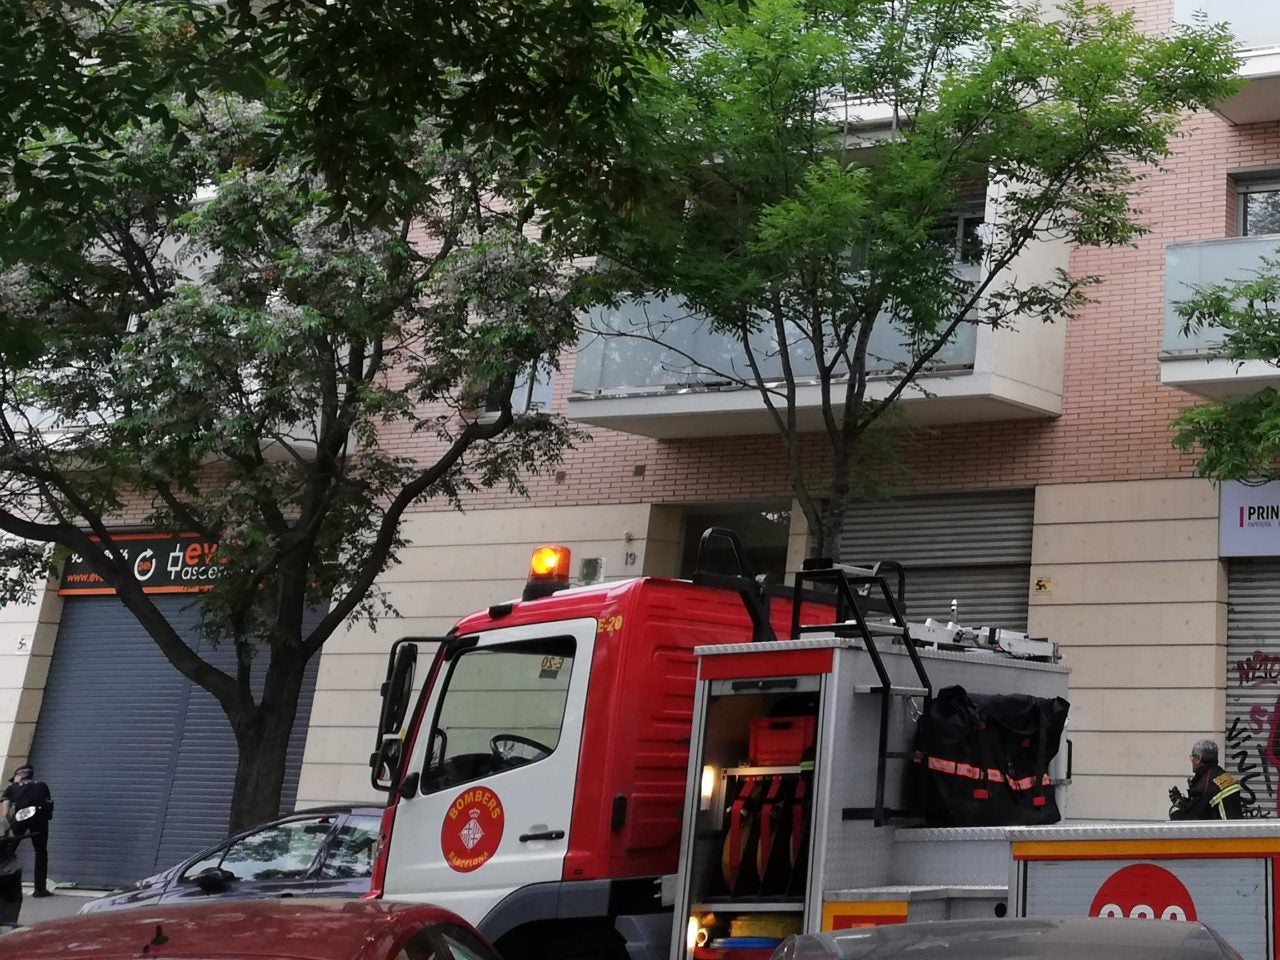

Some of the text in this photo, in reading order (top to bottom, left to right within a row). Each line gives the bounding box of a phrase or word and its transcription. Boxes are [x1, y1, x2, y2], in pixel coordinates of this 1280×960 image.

[625, 551, 637, 566] 19
[597, 615, 623, 633] E-20
[448, 790, 501, 820] BOMBERS
